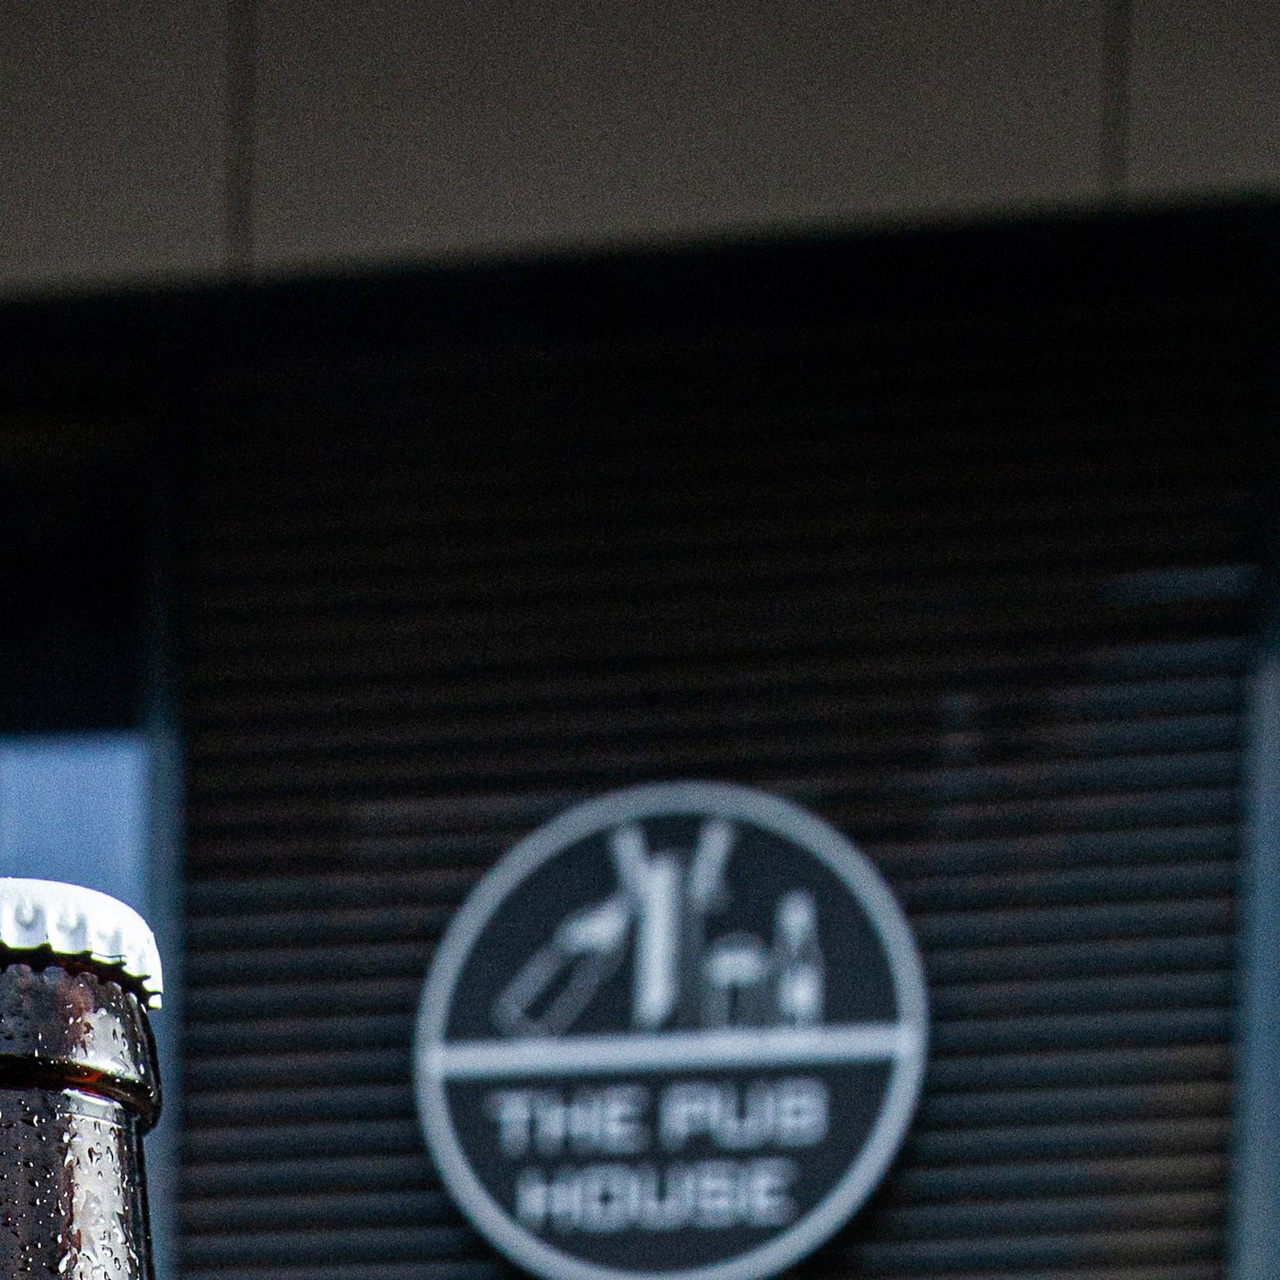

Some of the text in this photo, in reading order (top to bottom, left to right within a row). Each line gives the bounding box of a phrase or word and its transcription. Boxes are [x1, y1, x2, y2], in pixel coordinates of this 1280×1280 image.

[490, 1076, 828, 1158] THE PUB
[513, 1157, 796, 1235] HOUSE
